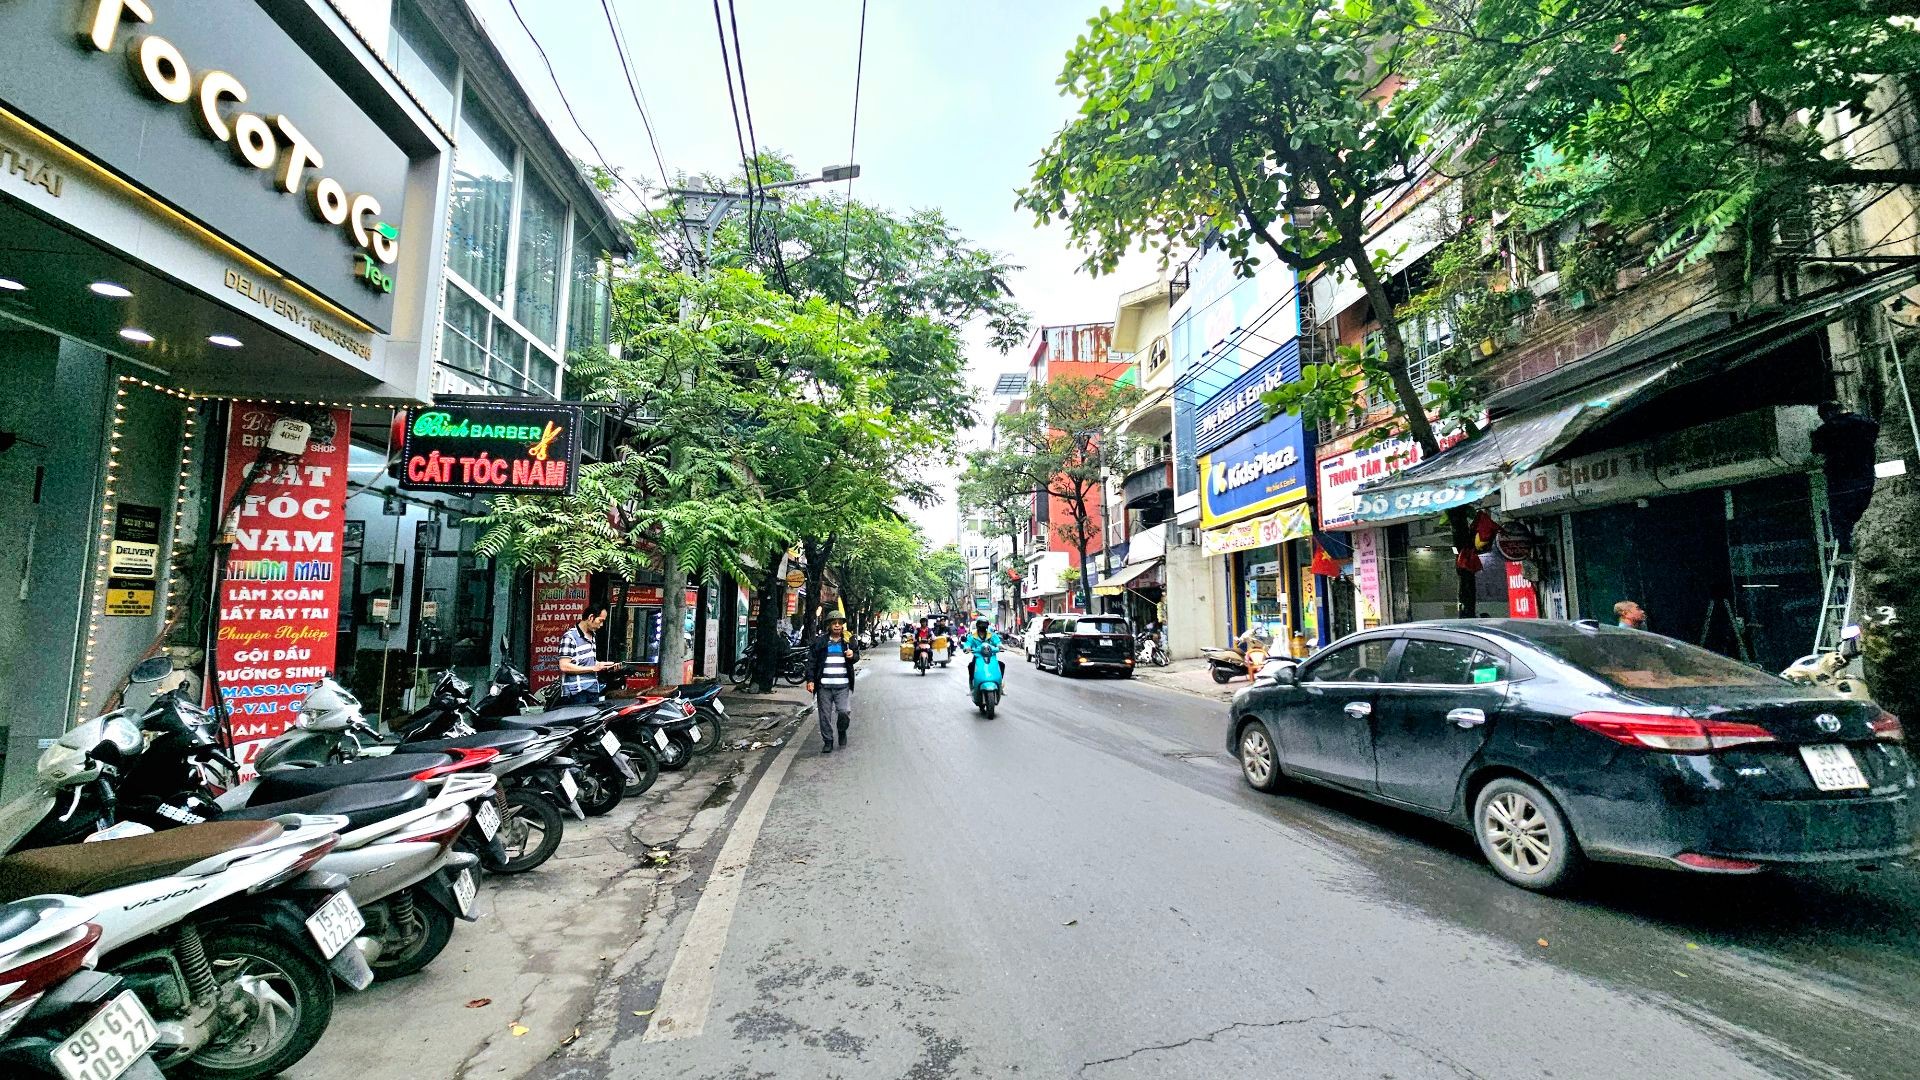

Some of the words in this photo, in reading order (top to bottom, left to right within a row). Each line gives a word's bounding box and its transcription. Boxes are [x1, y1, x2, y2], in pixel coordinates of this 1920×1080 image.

[364, 255, 392, 293] Tea
[1236, 392, 1246, 412] &
[1245, 383, 1265, 406] Em
[1264, 365, 1283, 392] bé
[470, 424, 542, 440] BARBER
[310, 443, 337, 453] SHOP
[408, 450, 456, 484] CẮT
[460, 451, 509, 485] TÓC
[512, 458, 567, 486] NAM
[1328, 466, 1358, 488] TRUNG
[1360, 459, 1381, 479] TÂM
[1558, 458, 1620, 488] CHƠI
[230, 529, 335, 553] NAM
[294, 558, 333, 582] MÀU
[229, 587, 267, 601] LÀM
[271, 587, 325, 601] XOĂN
[220, 604, 256, 621] LẤY
[260, 605, 298, 620] RÁY
[301, 607, 329, 619] TAI
[540, 602, 558, 611] LÀM
[559, 602, 583, 611] XOĂN
[573, 613, 583, 621] TA
[217, 626, 272, 646] Chuyên
[274, 625, 329, 645] Nghiệp
[233, 648, 270, 665] GỘI
[273, 644, 311, 661] ĐẦU
[218, 665, 282, 682] DƯỠNG
[285, 666, 327, 680] SINH
[123, 882, 207, 911] VISION
[322, 910, 361, 953] 122.25
[68, 1003, 133, 1064] 99-G1
